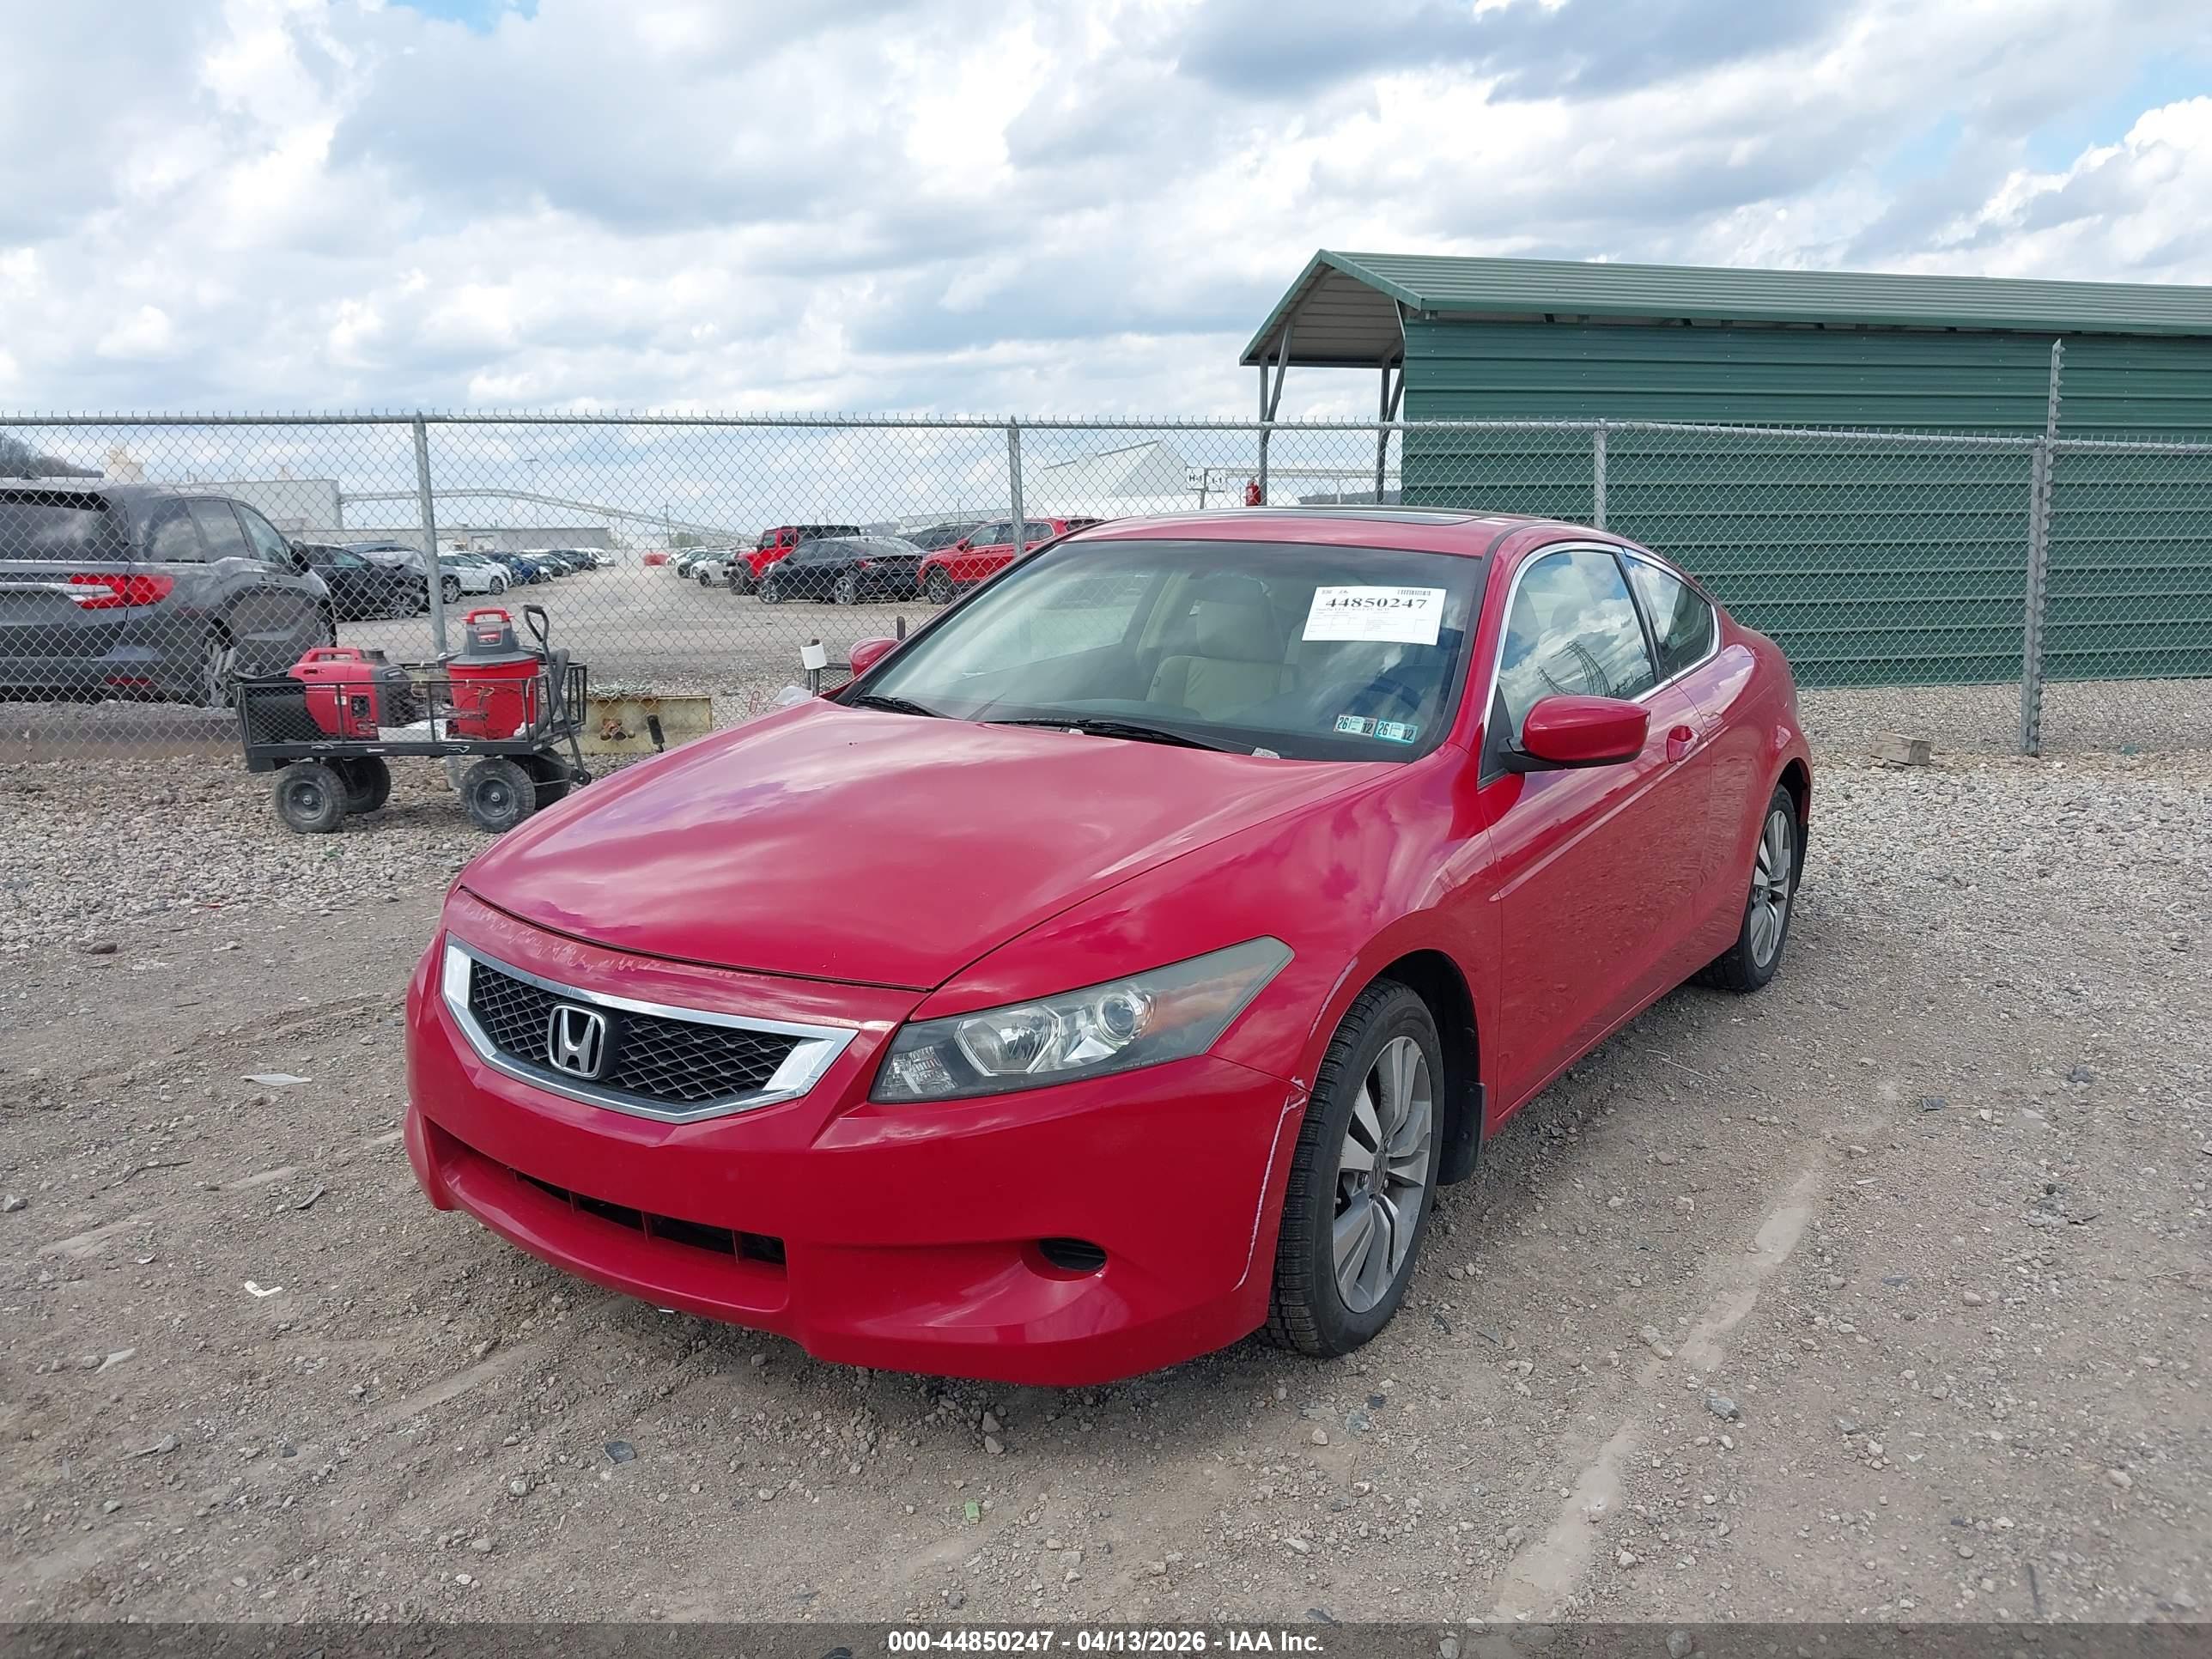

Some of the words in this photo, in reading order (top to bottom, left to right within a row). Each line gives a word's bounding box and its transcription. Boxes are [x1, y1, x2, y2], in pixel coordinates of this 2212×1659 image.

[1325, 598, 1428, 609] 44850247
[1337, 716, 1349, 729] 26
[1362, 722, 1374, 734] 12
[1377, 722, 1389, 736] 26
[1402, 727, 1414, 741] 12
